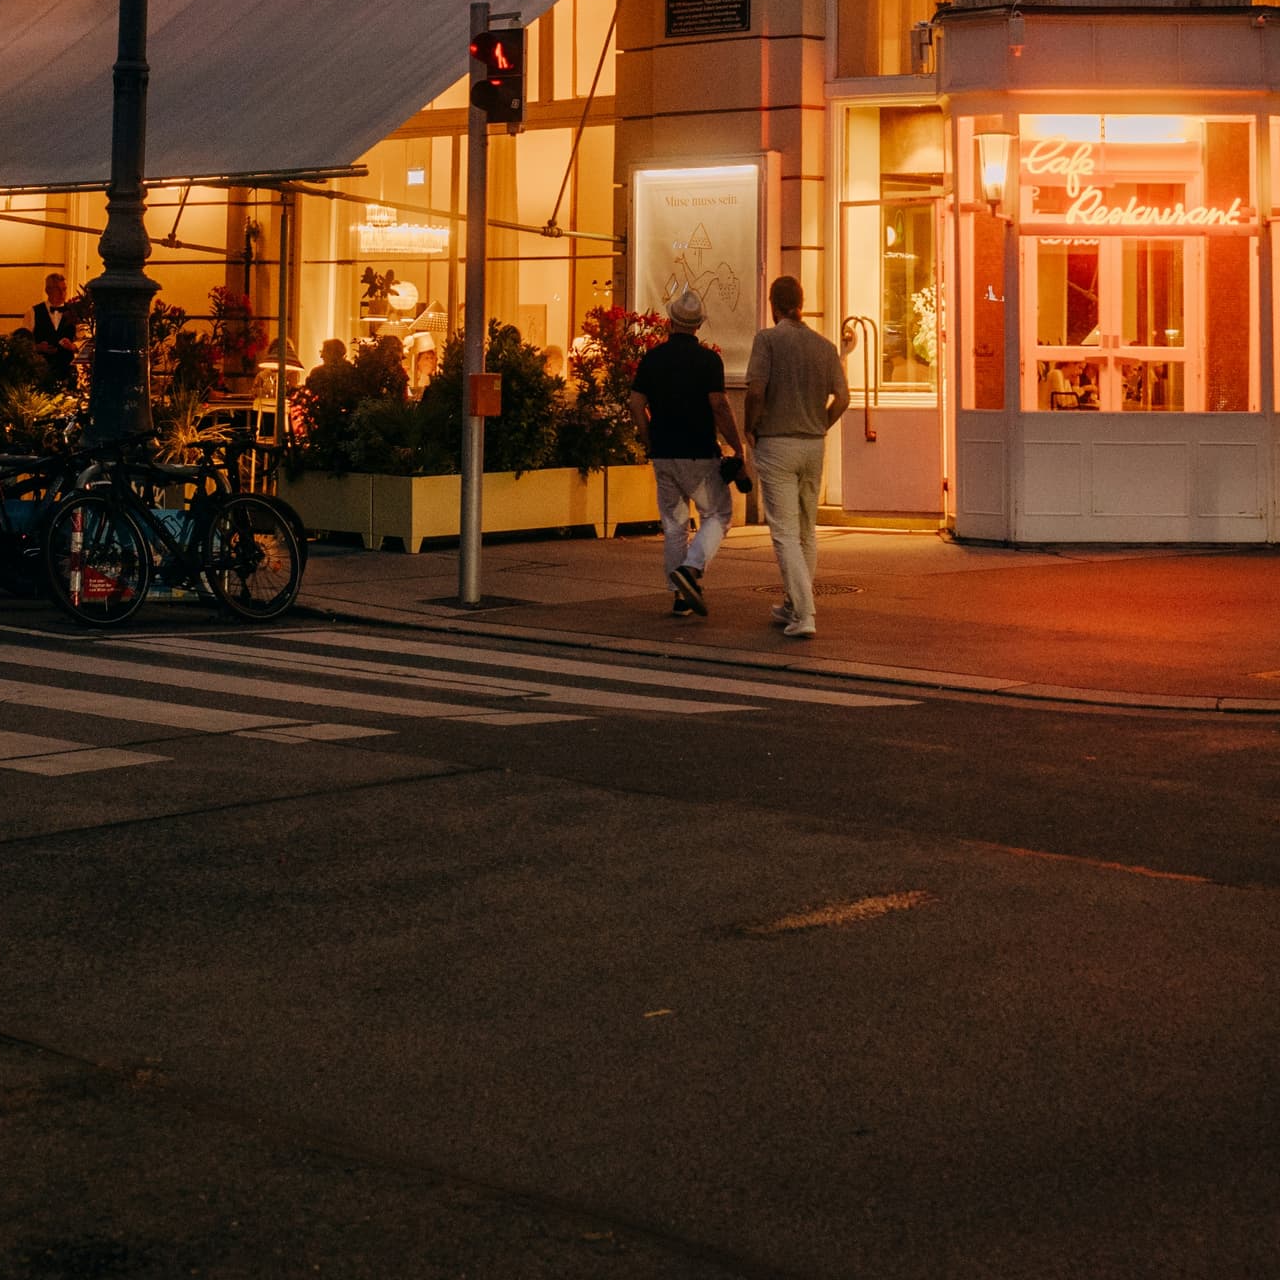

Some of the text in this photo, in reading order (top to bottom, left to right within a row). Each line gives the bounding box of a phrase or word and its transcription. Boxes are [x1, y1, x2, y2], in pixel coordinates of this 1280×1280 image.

[664, 196, 689, 208] Muse
[692, 197, 716, 207] muss
[1066, 186, 1242, 226] Restaurant
